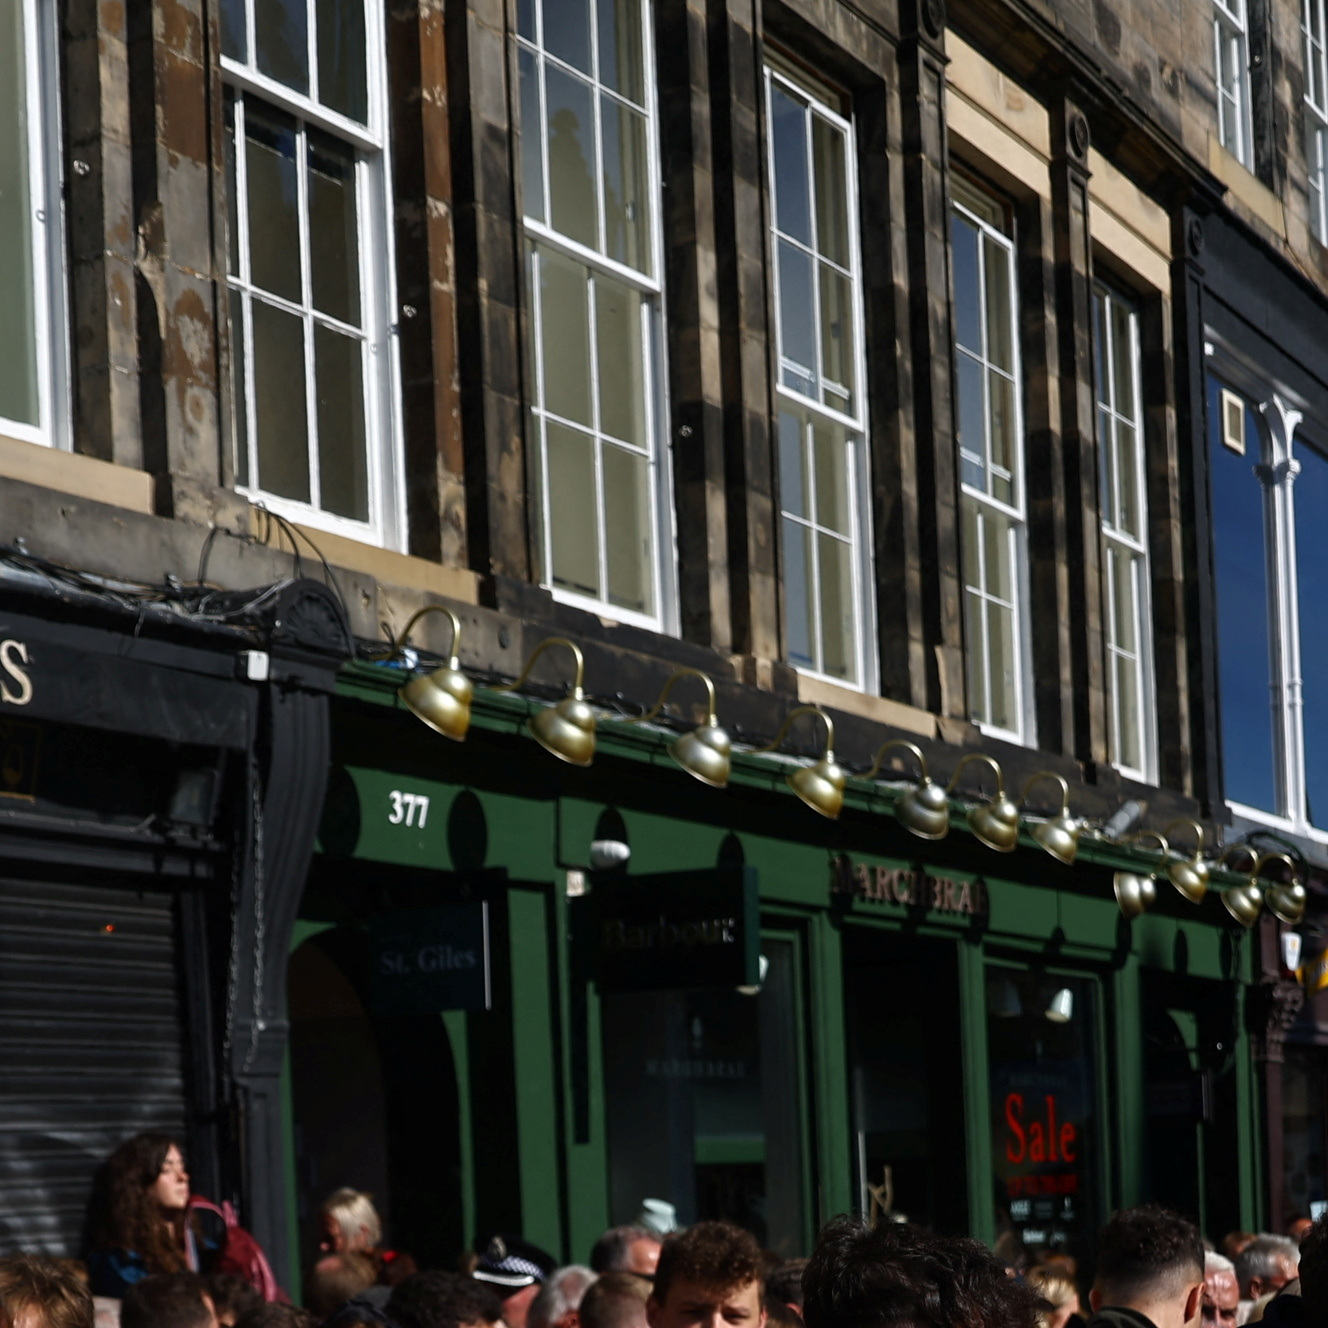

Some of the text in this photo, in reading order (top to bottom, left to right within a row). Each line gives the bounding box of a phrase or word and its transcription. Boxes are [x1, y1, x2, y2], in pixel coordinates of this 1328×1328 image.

[388, 790, 429, 828] 377
[417, 944, 477, 973] Giles
[1005, 1091, 1078, 1165] Sale
